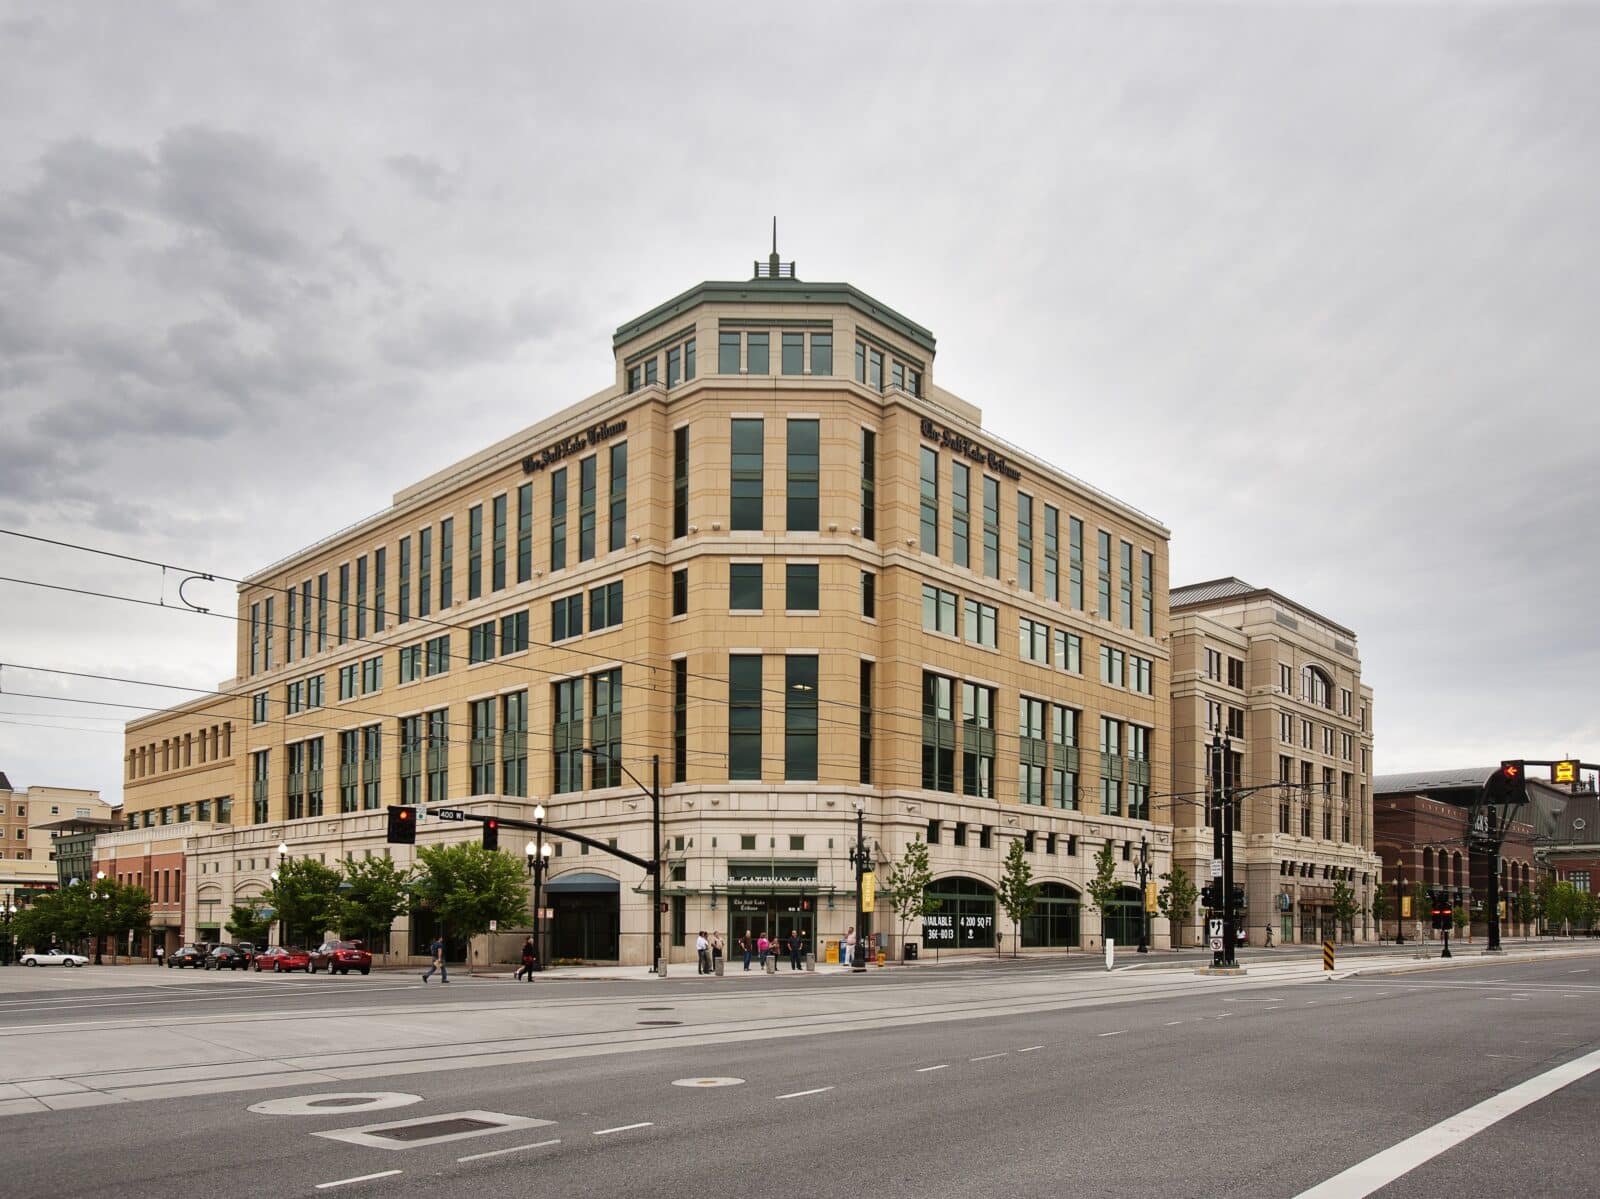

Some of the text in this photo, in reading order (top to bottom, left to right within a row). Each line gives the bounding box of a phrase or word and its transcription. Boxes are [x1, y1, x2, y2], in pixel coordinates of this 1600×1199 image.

[440, 811, 454, 819] 400
[922, 916, 952, 926] AVAILABLE
[985, 917, 992, 927] FT
